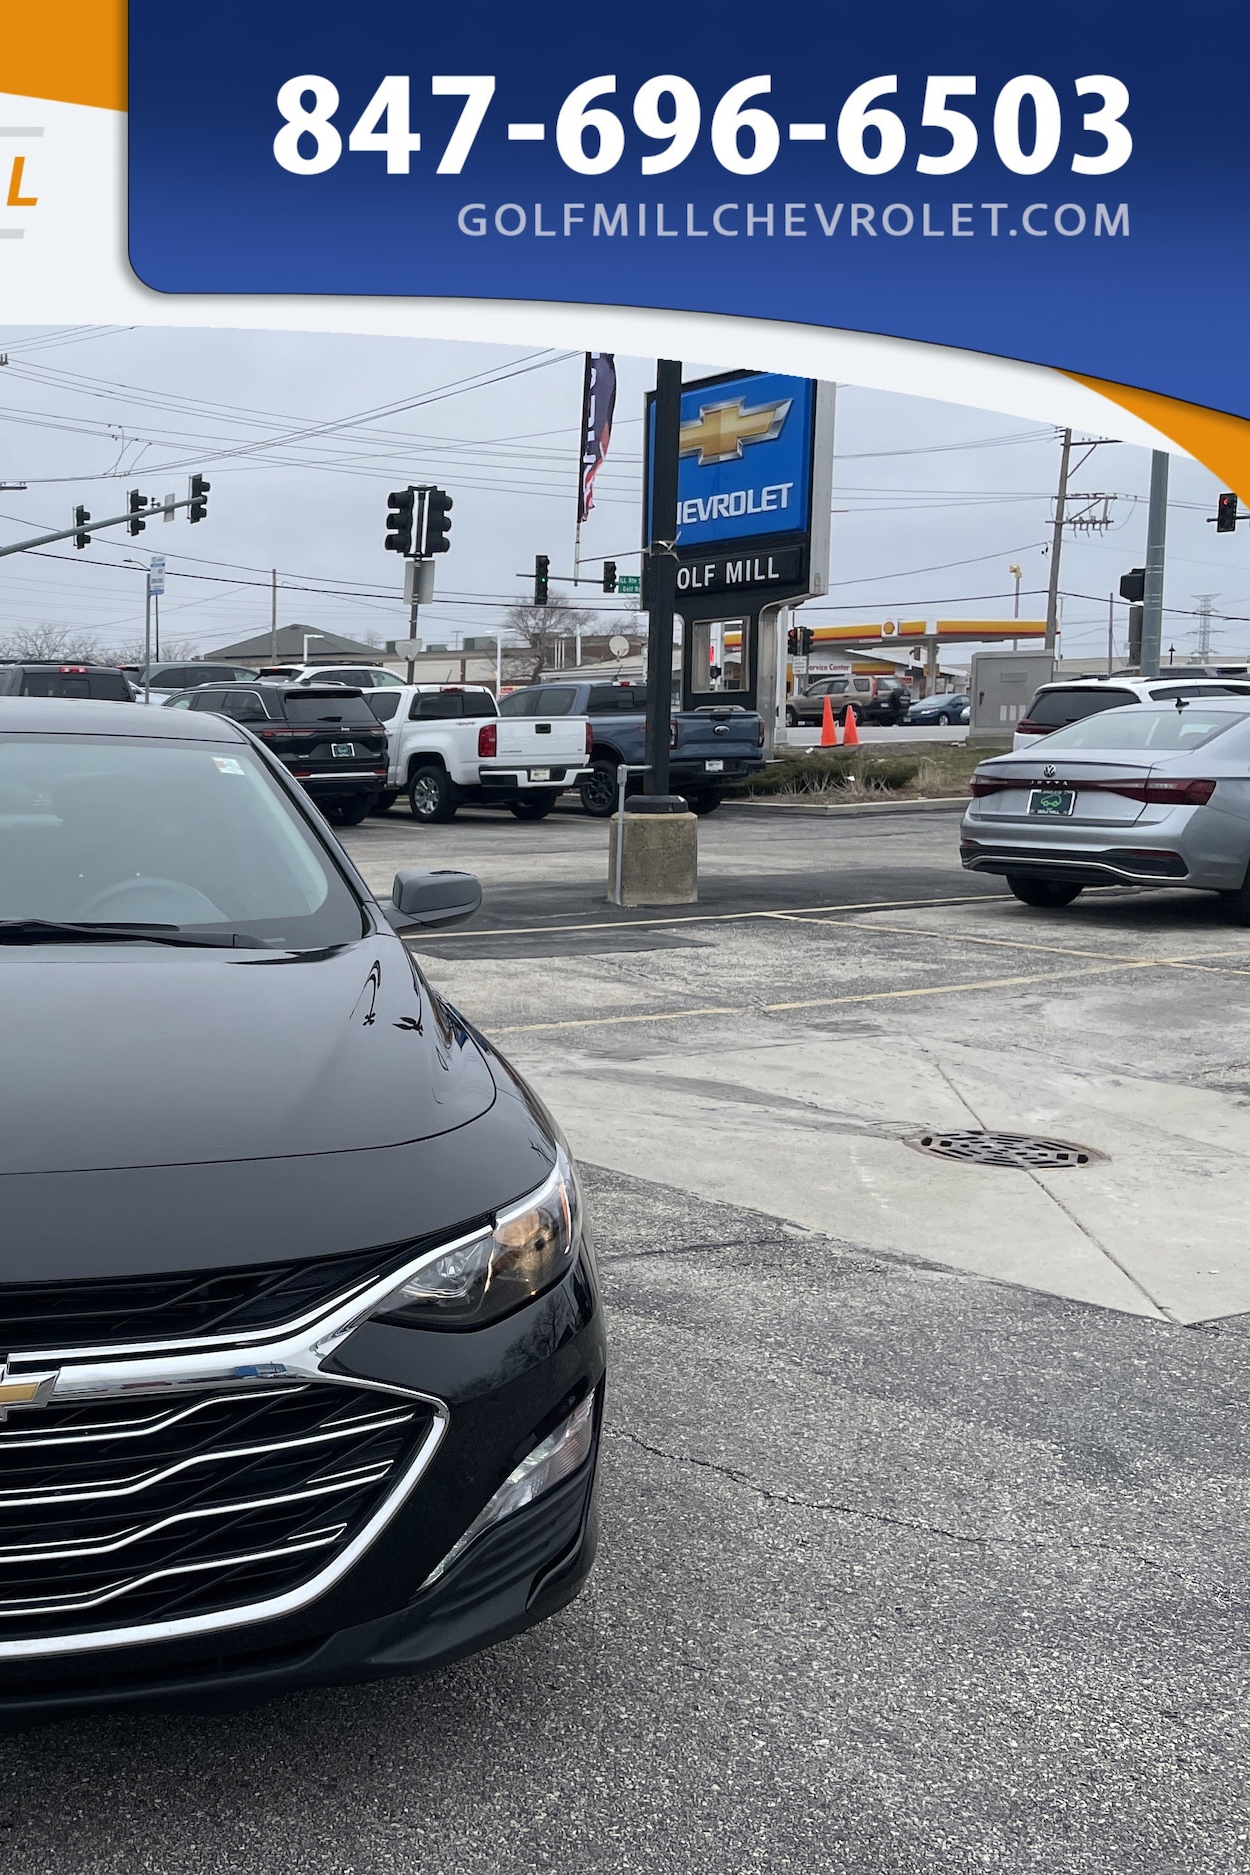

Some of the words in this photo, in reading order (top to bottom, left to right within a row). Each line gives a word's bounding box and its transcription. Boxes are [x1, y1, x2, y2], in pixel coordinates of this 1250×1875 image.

[676, 482, 794, 526] EVROLET
[676, 564, 716, 590] OLF
[725, 556, 780, 584] MILL
[829, 662, 849, 671] Center
